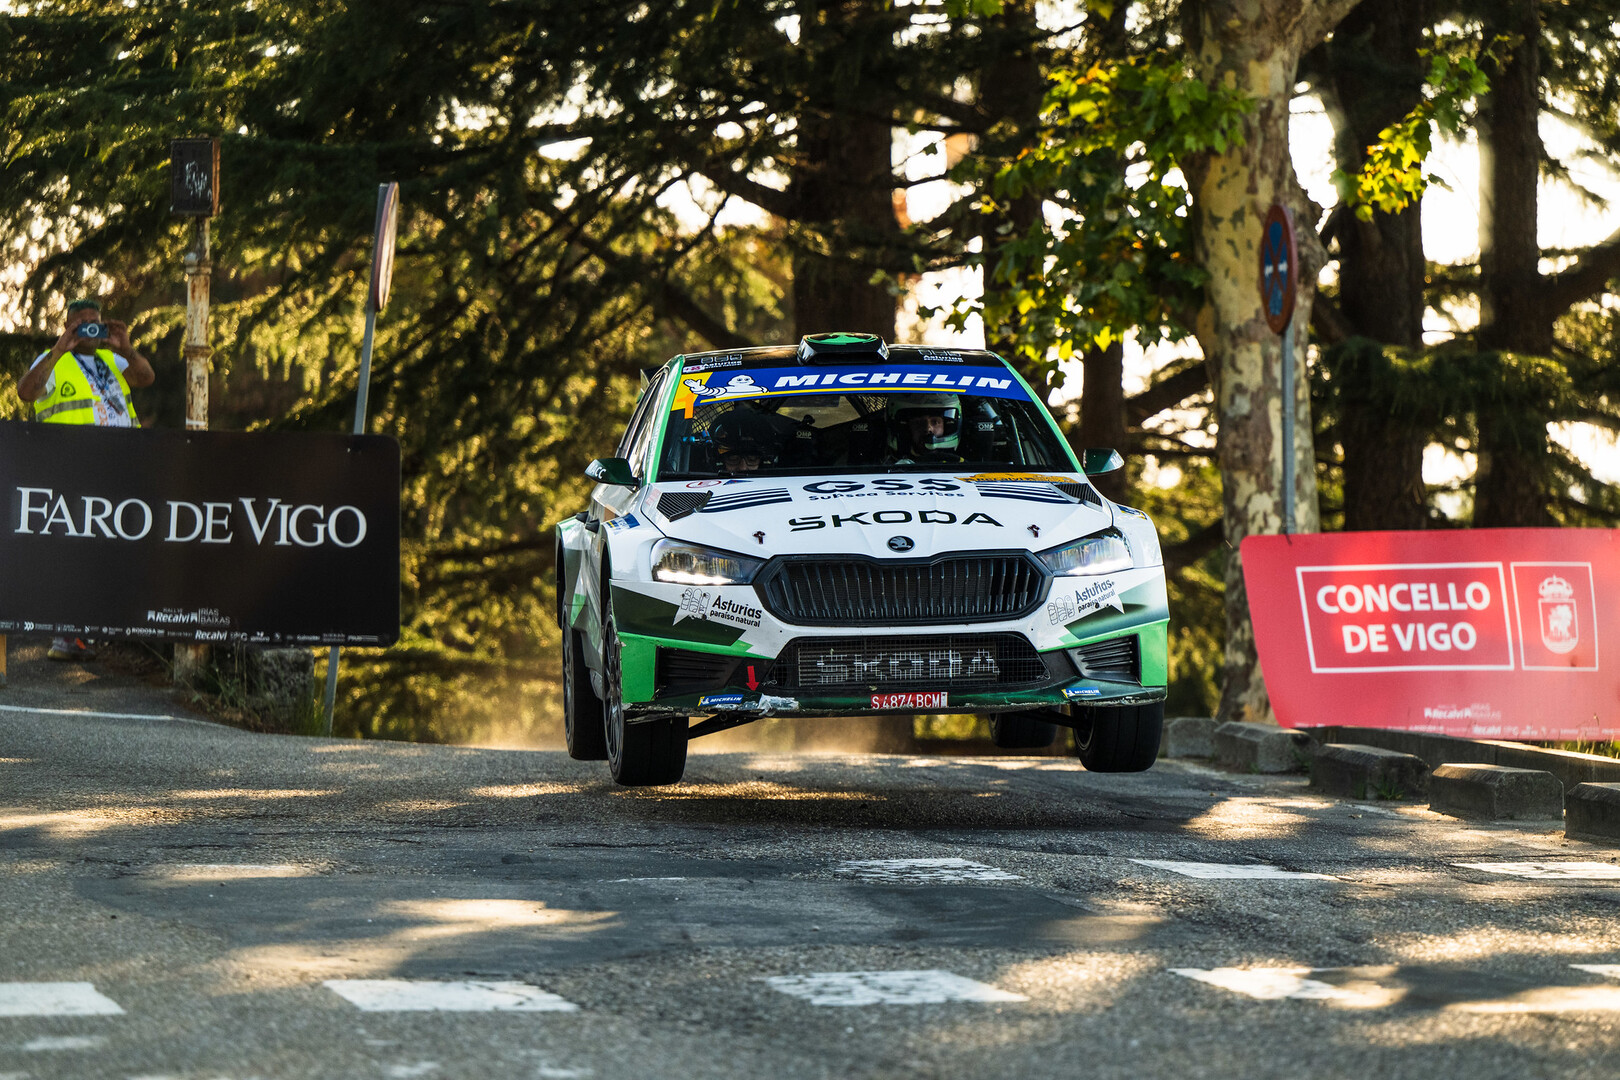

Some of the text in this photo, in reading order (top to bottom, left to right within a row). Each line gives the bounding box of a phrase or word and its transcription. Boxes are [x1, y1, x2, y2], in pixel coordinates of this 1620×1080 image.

[773, 372, 1013, 390] MICHELIN
[677, 393, 694, 419] 1
[977, 423, 994, 431] OMP
[803, 478, 961, 493] GSS
[808, 493, 878, 501] Subsea
[14, 486, 368, 548] FARO DE VIGO
[1075, 580, 1112, 604] Asturias
[1097, 590, 1115, 604] natural
[1316, 581, 1491, 614] CONCELLO
[712, 594, 763, 619] Asturias
[156, 611, 191, 624] Recalvi
[200, 615, 231, 626] BAIXAS
[735, 615, 761, 628] natural
[195, 629, 228, 641] Recalvi
[1341, 621, 1478, 654] DE VIGO
